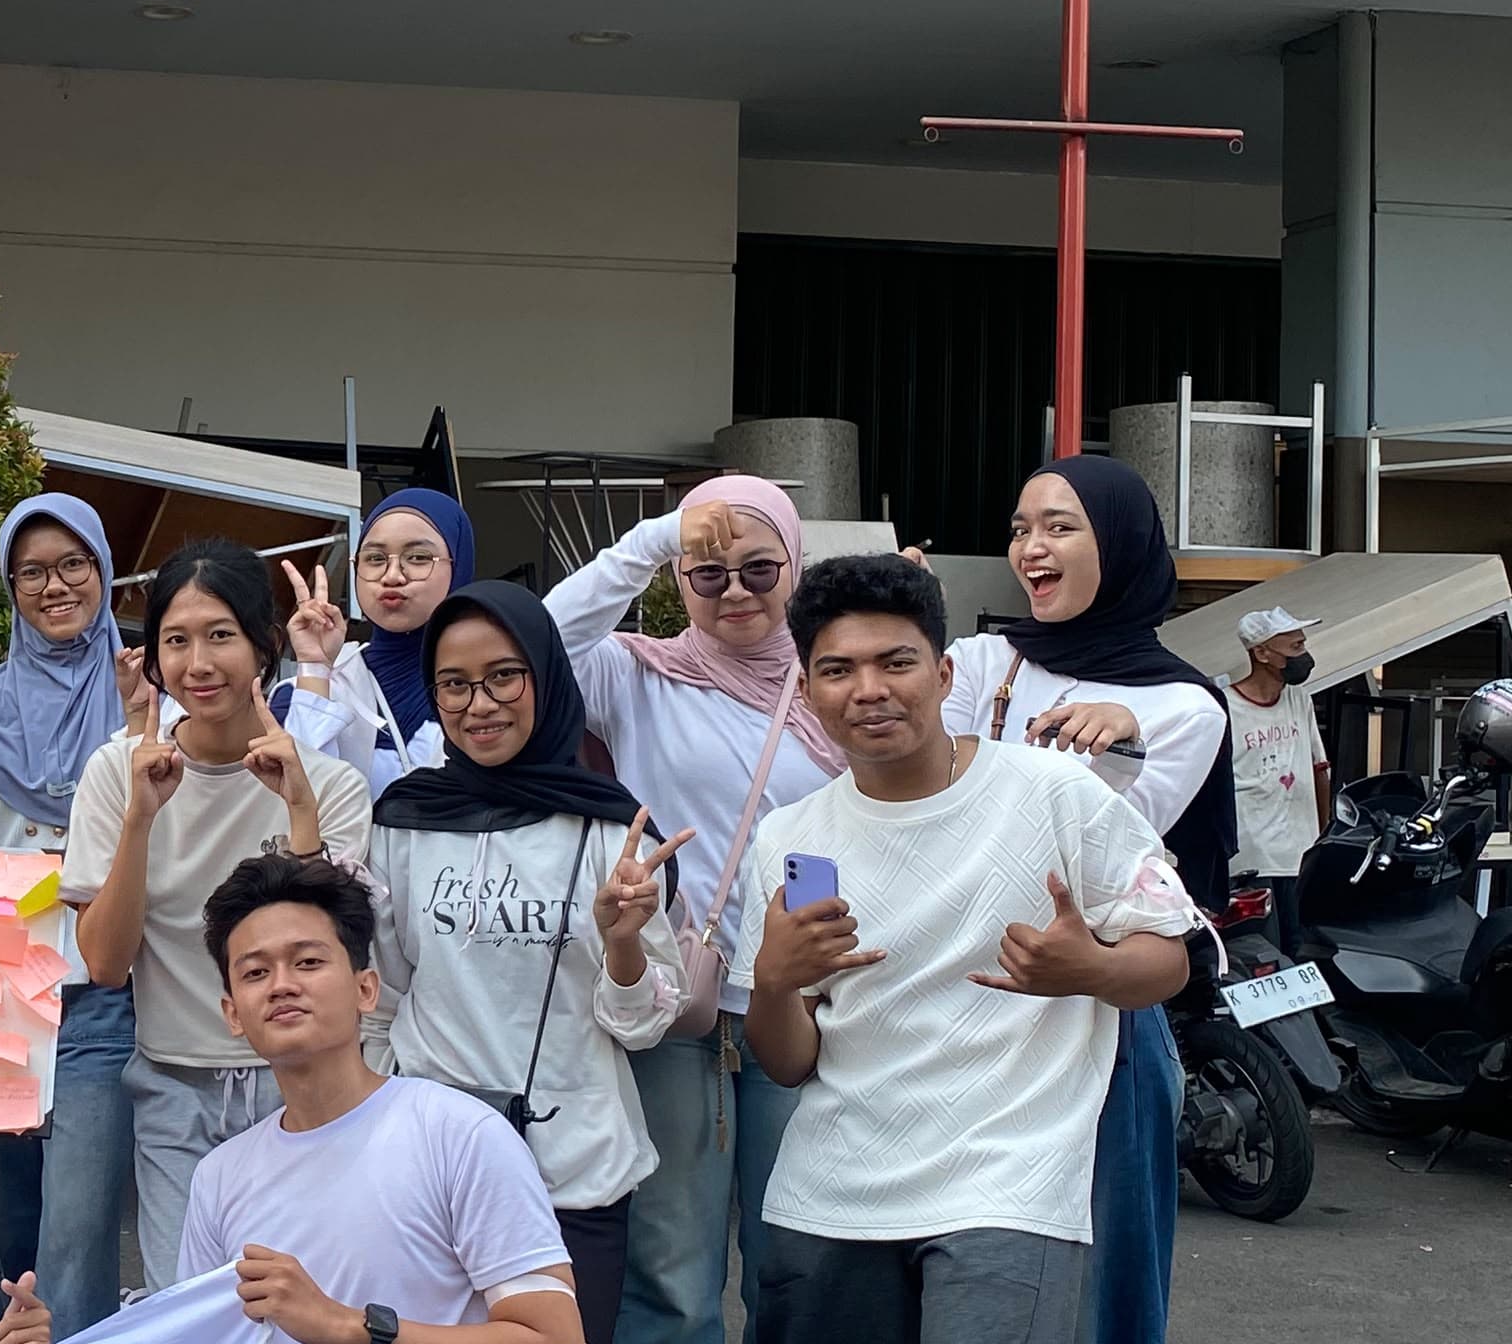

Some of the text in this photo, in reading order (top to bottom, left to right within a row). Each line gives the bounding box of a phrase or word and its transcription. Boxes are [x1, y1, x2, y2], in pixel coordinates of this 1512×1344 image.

[423, 863, 520, 913] fresh
[432, 899, 579, 935] START
[1227, 989, 1242, 1006] K
[1247, 975, 1288, 999] 3779
